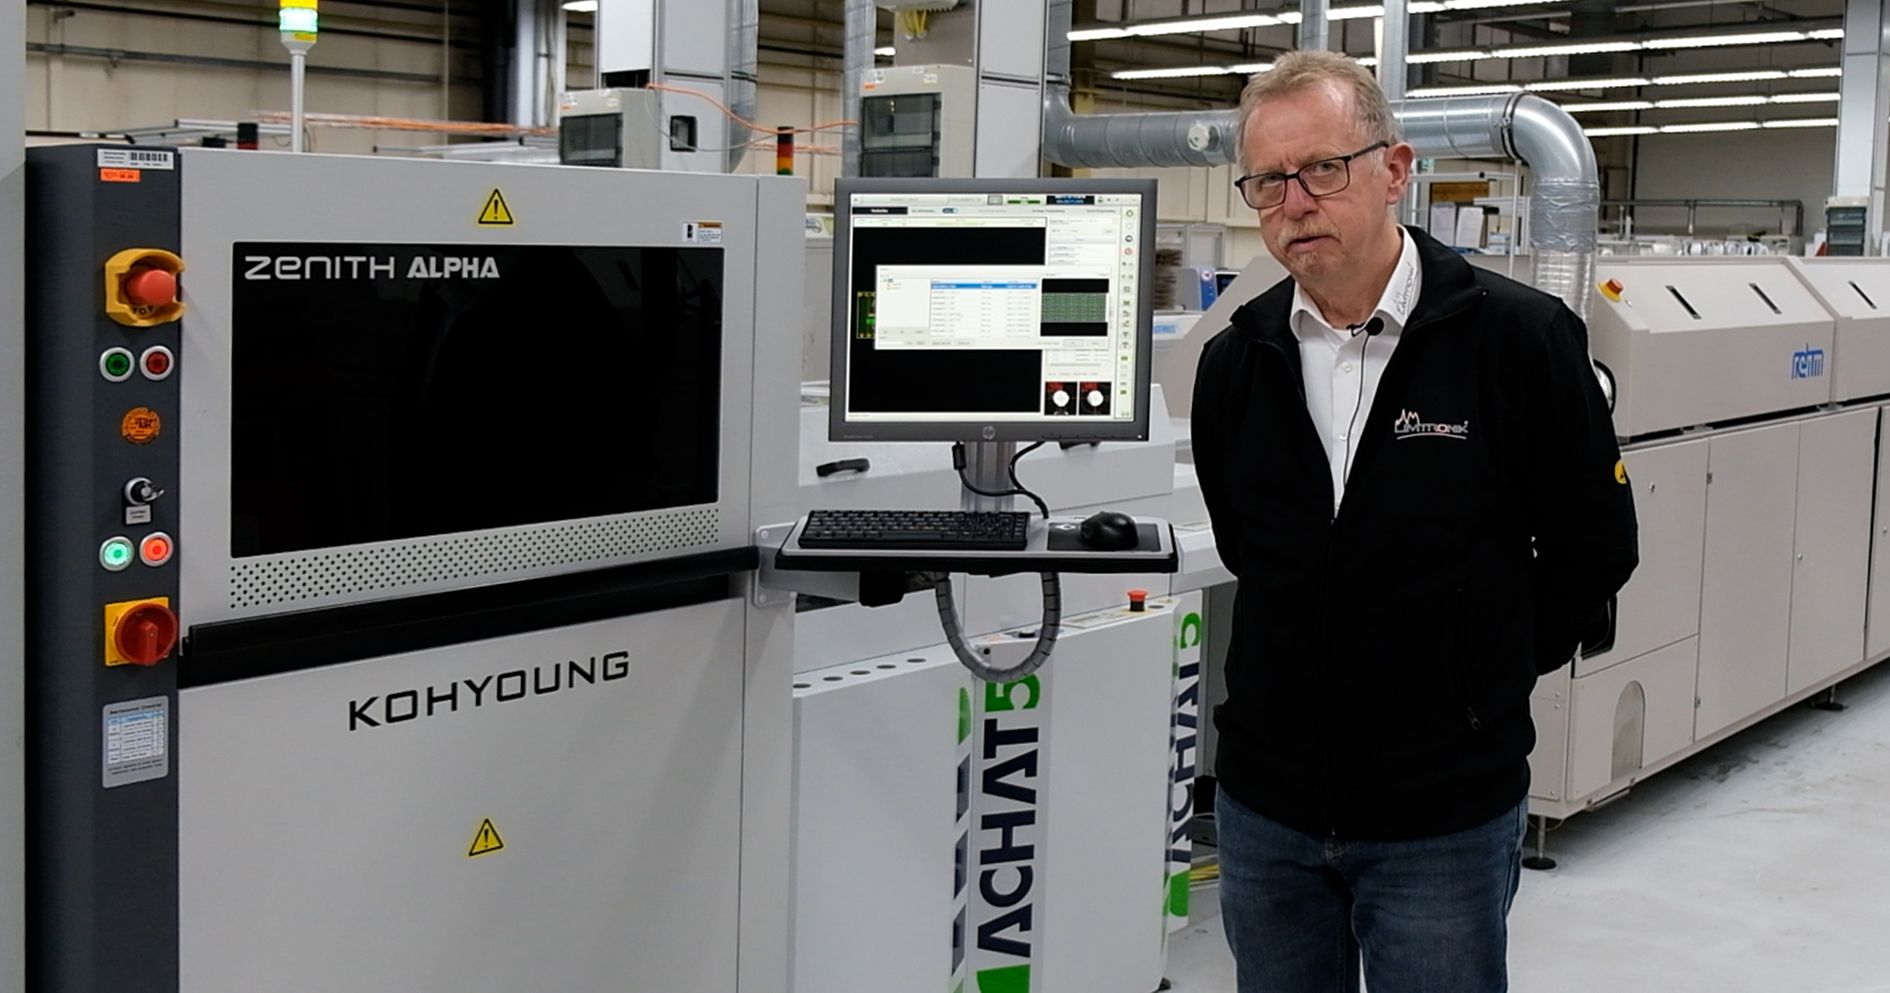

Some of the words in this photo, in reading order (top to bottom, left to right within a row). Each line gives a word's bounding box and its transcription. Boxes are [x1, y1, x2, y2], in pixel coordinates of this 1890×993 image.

[407, 256, 500, 279] ALPHA
[1791, 342, 1824, 380] rehm
[349, 650, 629, 731] KOHYOUNG
